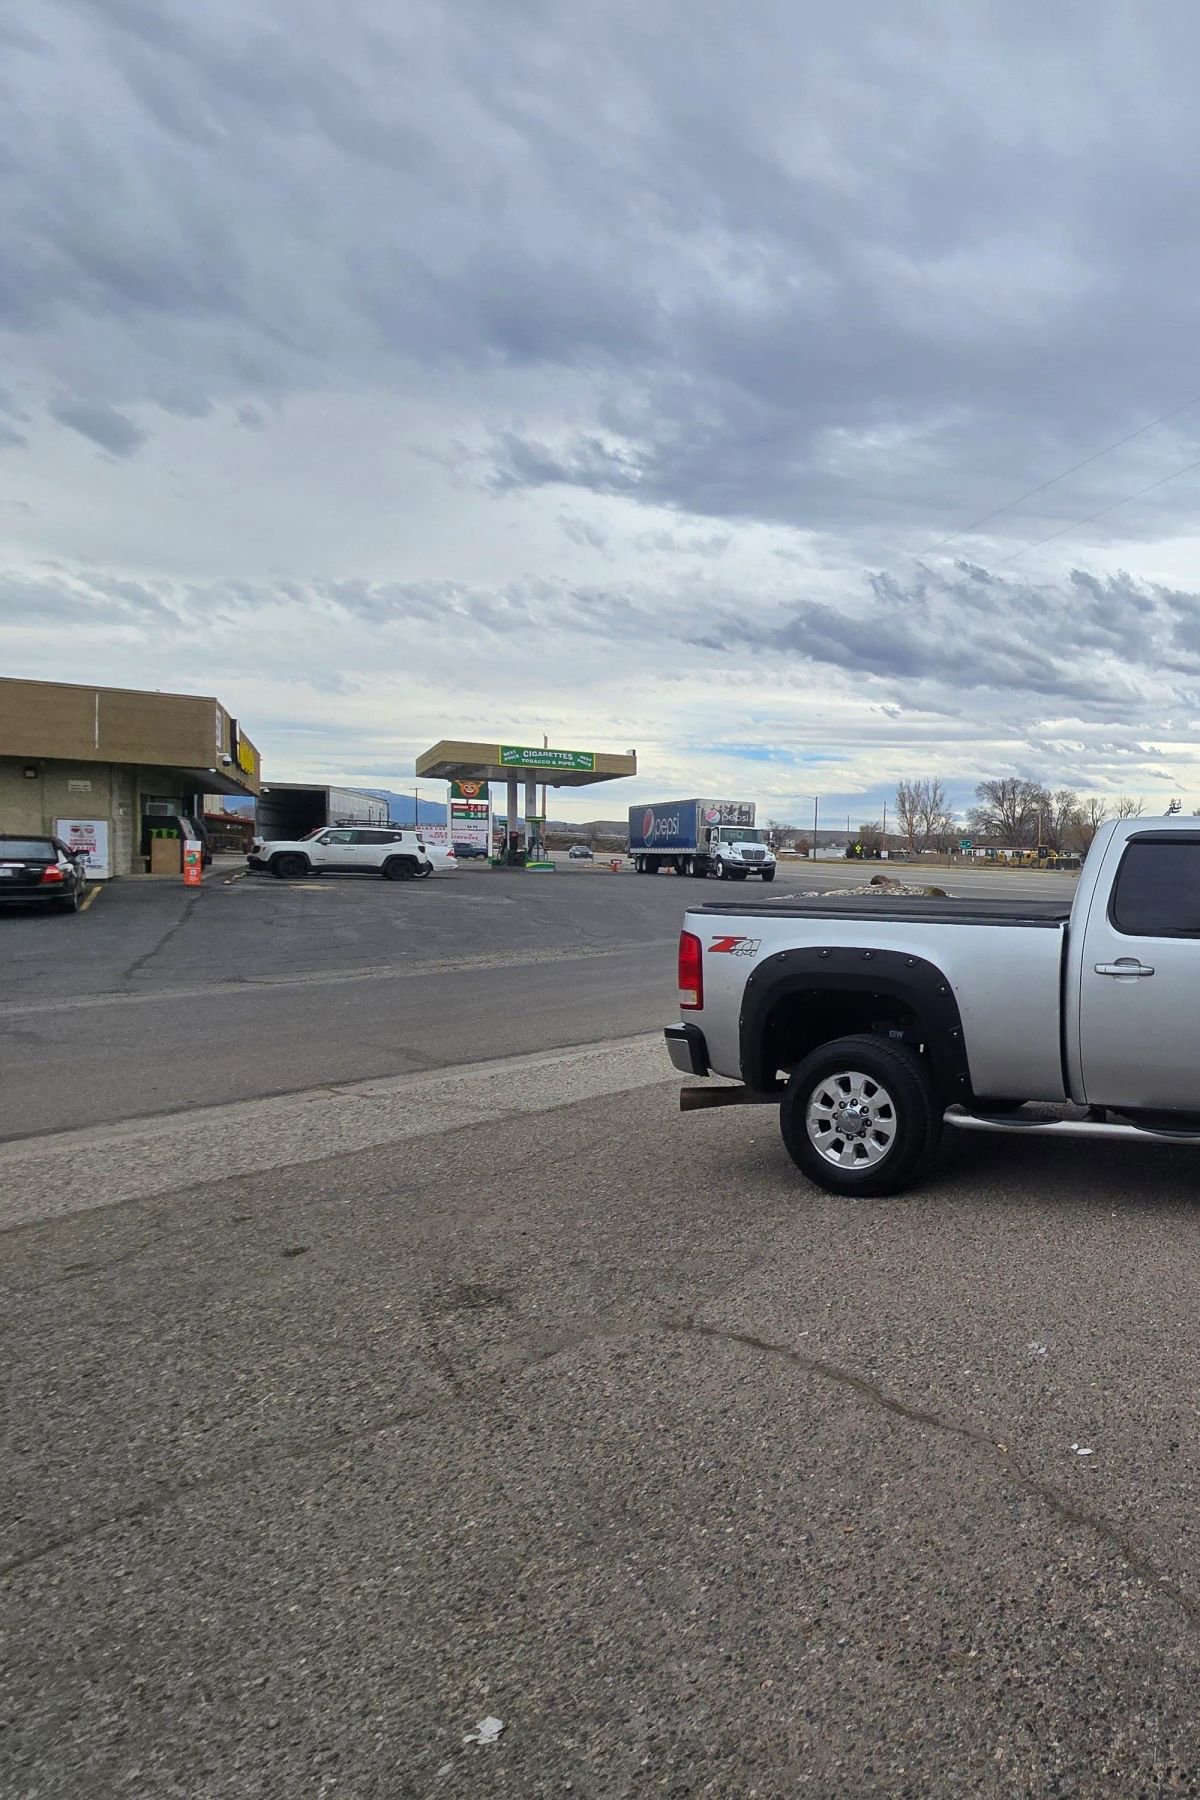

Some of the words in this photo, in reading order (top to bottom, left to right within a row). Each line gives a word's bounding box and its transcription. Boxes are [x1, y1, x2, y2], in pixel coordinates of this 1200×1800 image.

[523, 750, 573, 760] CIGARETTES
[721, 813, 749, 823] pepsi
[654, 812, 680, 840] pepsi
